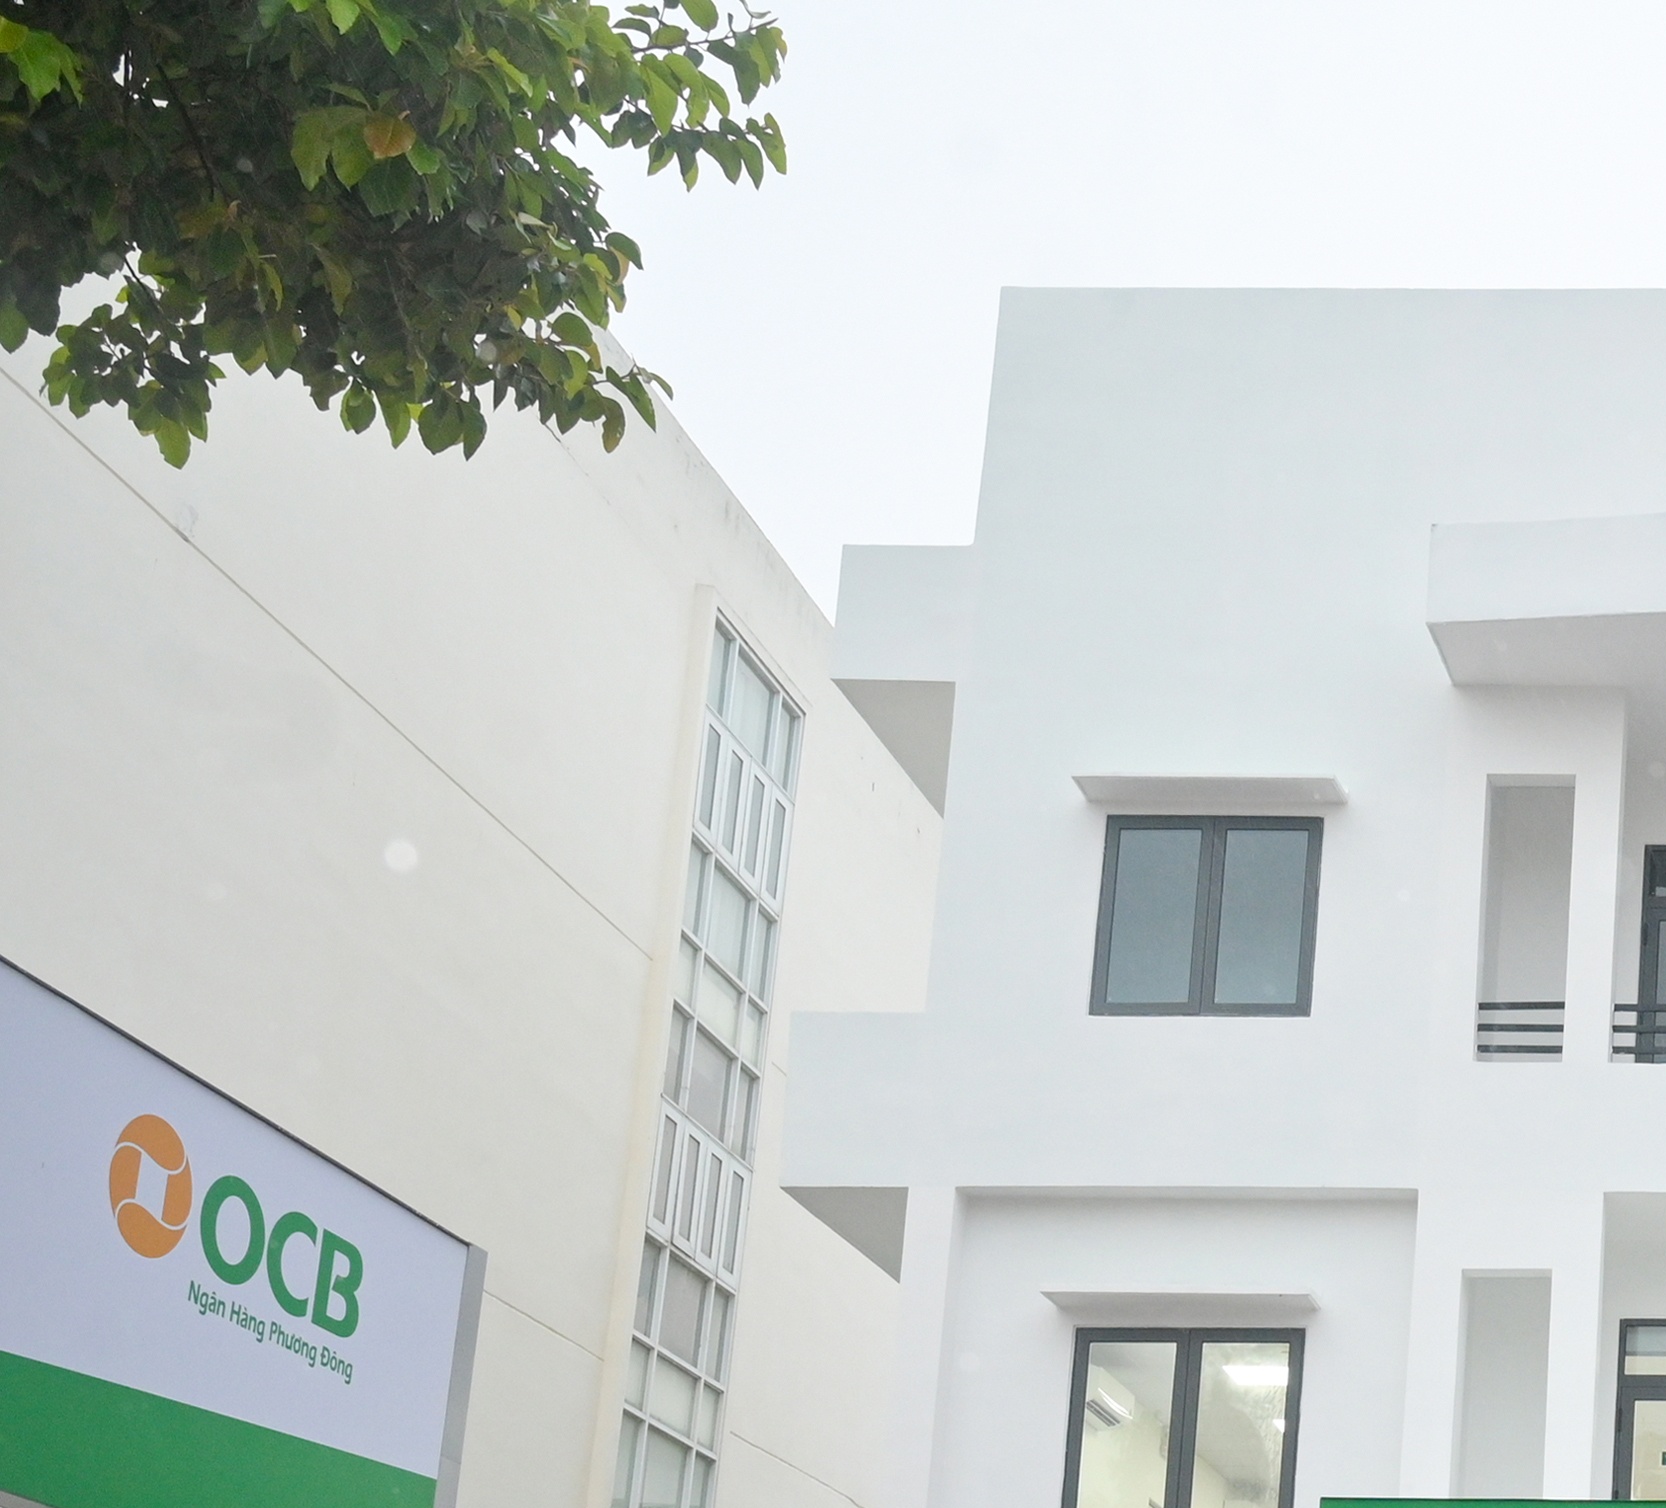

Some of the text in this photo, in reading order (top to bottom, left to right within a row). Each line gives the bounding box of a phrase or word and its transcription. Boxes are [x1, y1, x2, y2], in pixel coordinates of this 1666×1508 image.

[200, 1175, 363, 1338] OCB
[188, 1280, 353, 1385] Ngân Hàng Phương Đông
